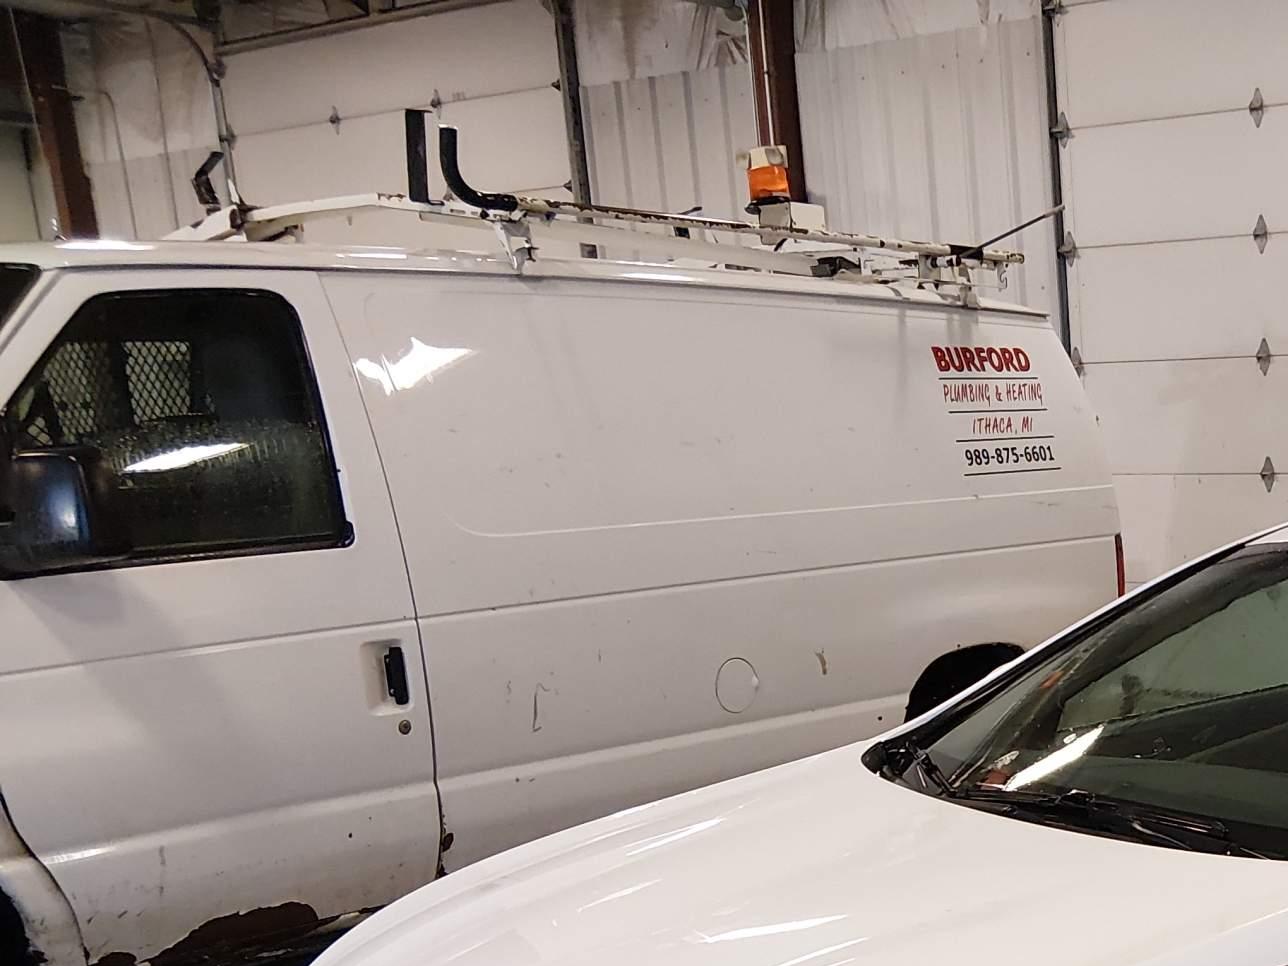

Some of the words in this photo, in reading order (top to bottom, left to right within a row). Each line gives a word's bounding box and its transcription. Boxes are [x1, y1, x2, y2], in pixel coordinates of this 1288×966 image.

[931, 346, 1031, 373] BURFORD
[943, 384, 991, 406] PLUMBING
[995, 386, 1003, 402] &
[1006, 383, 1043, 406] HEATING
[973, 417, 1018, 435] ITHACA,
[1021, 416, 1033, 432] MI
[964, 445, 1055, 467] 989-875-6601
